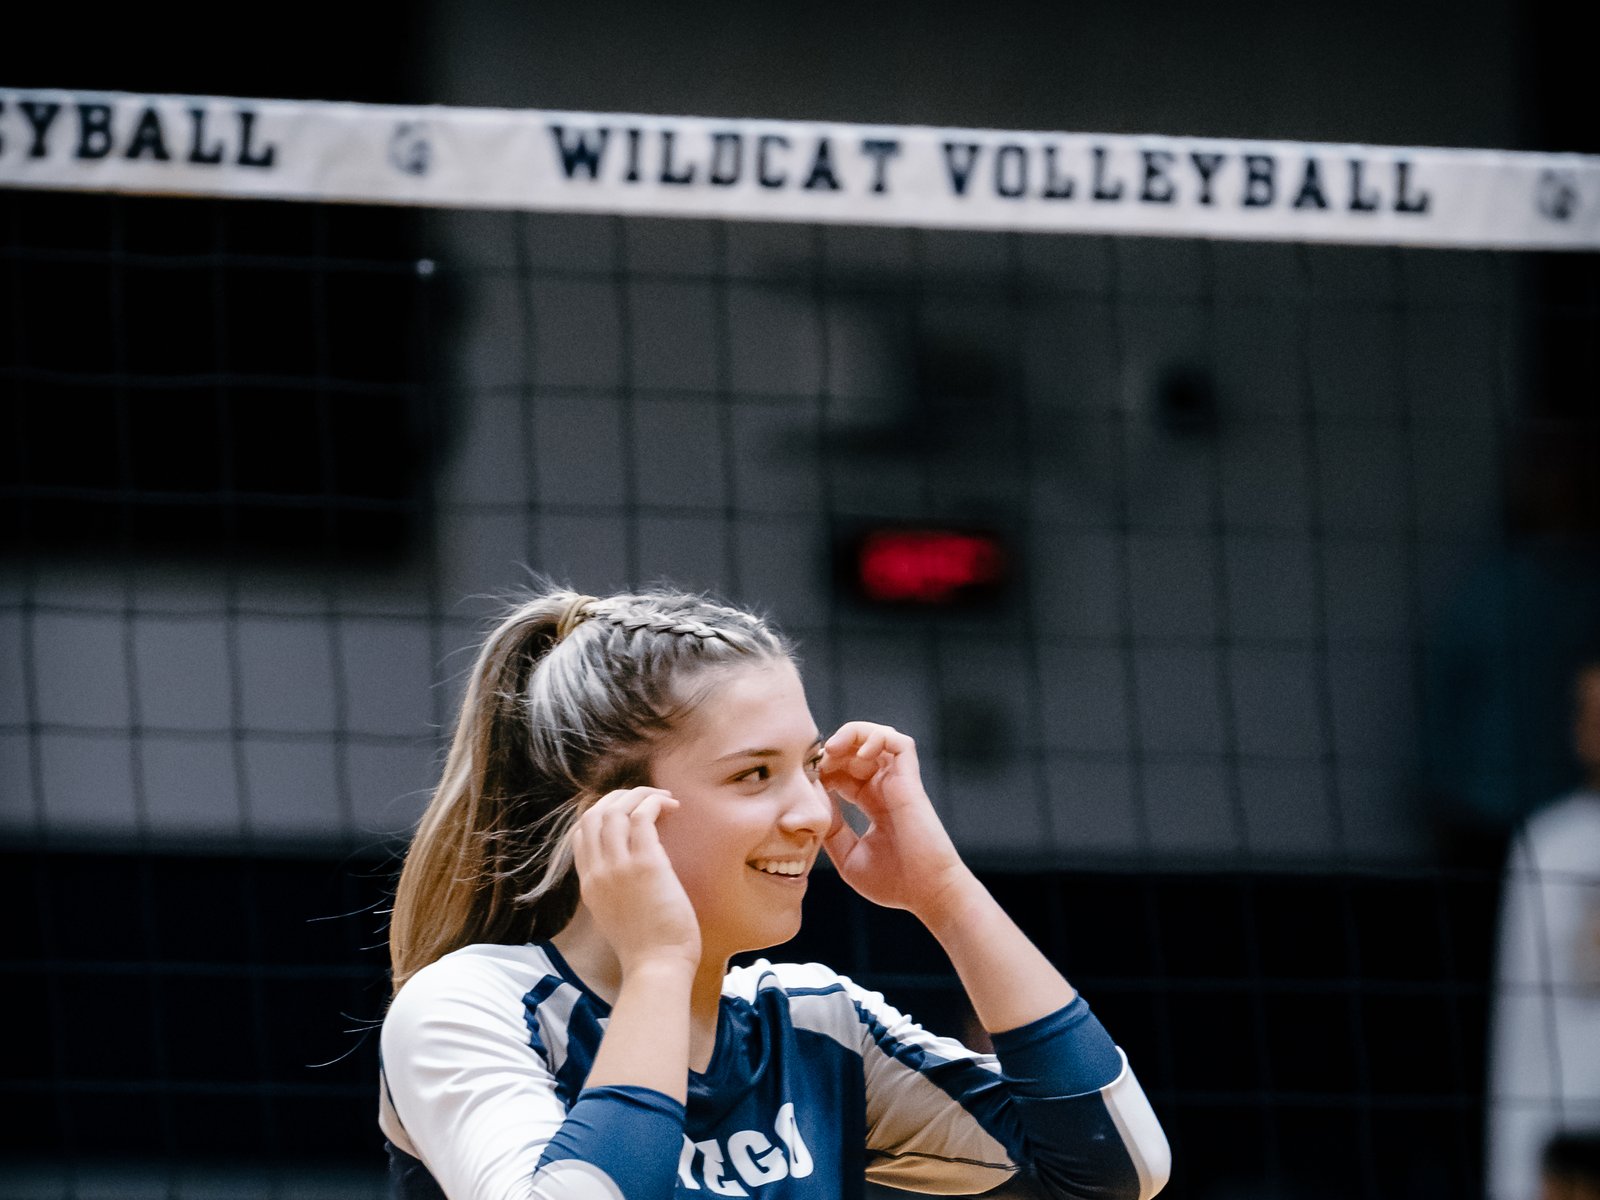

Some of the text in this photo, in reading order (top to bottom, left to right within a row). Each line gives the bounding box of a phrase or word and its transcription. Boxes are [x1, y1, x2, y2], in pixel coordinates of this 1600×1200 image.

[0, 102, 276, 167] YBALL
[550, 125, 1430, 214] WILDCAT VOLLEYBALL
